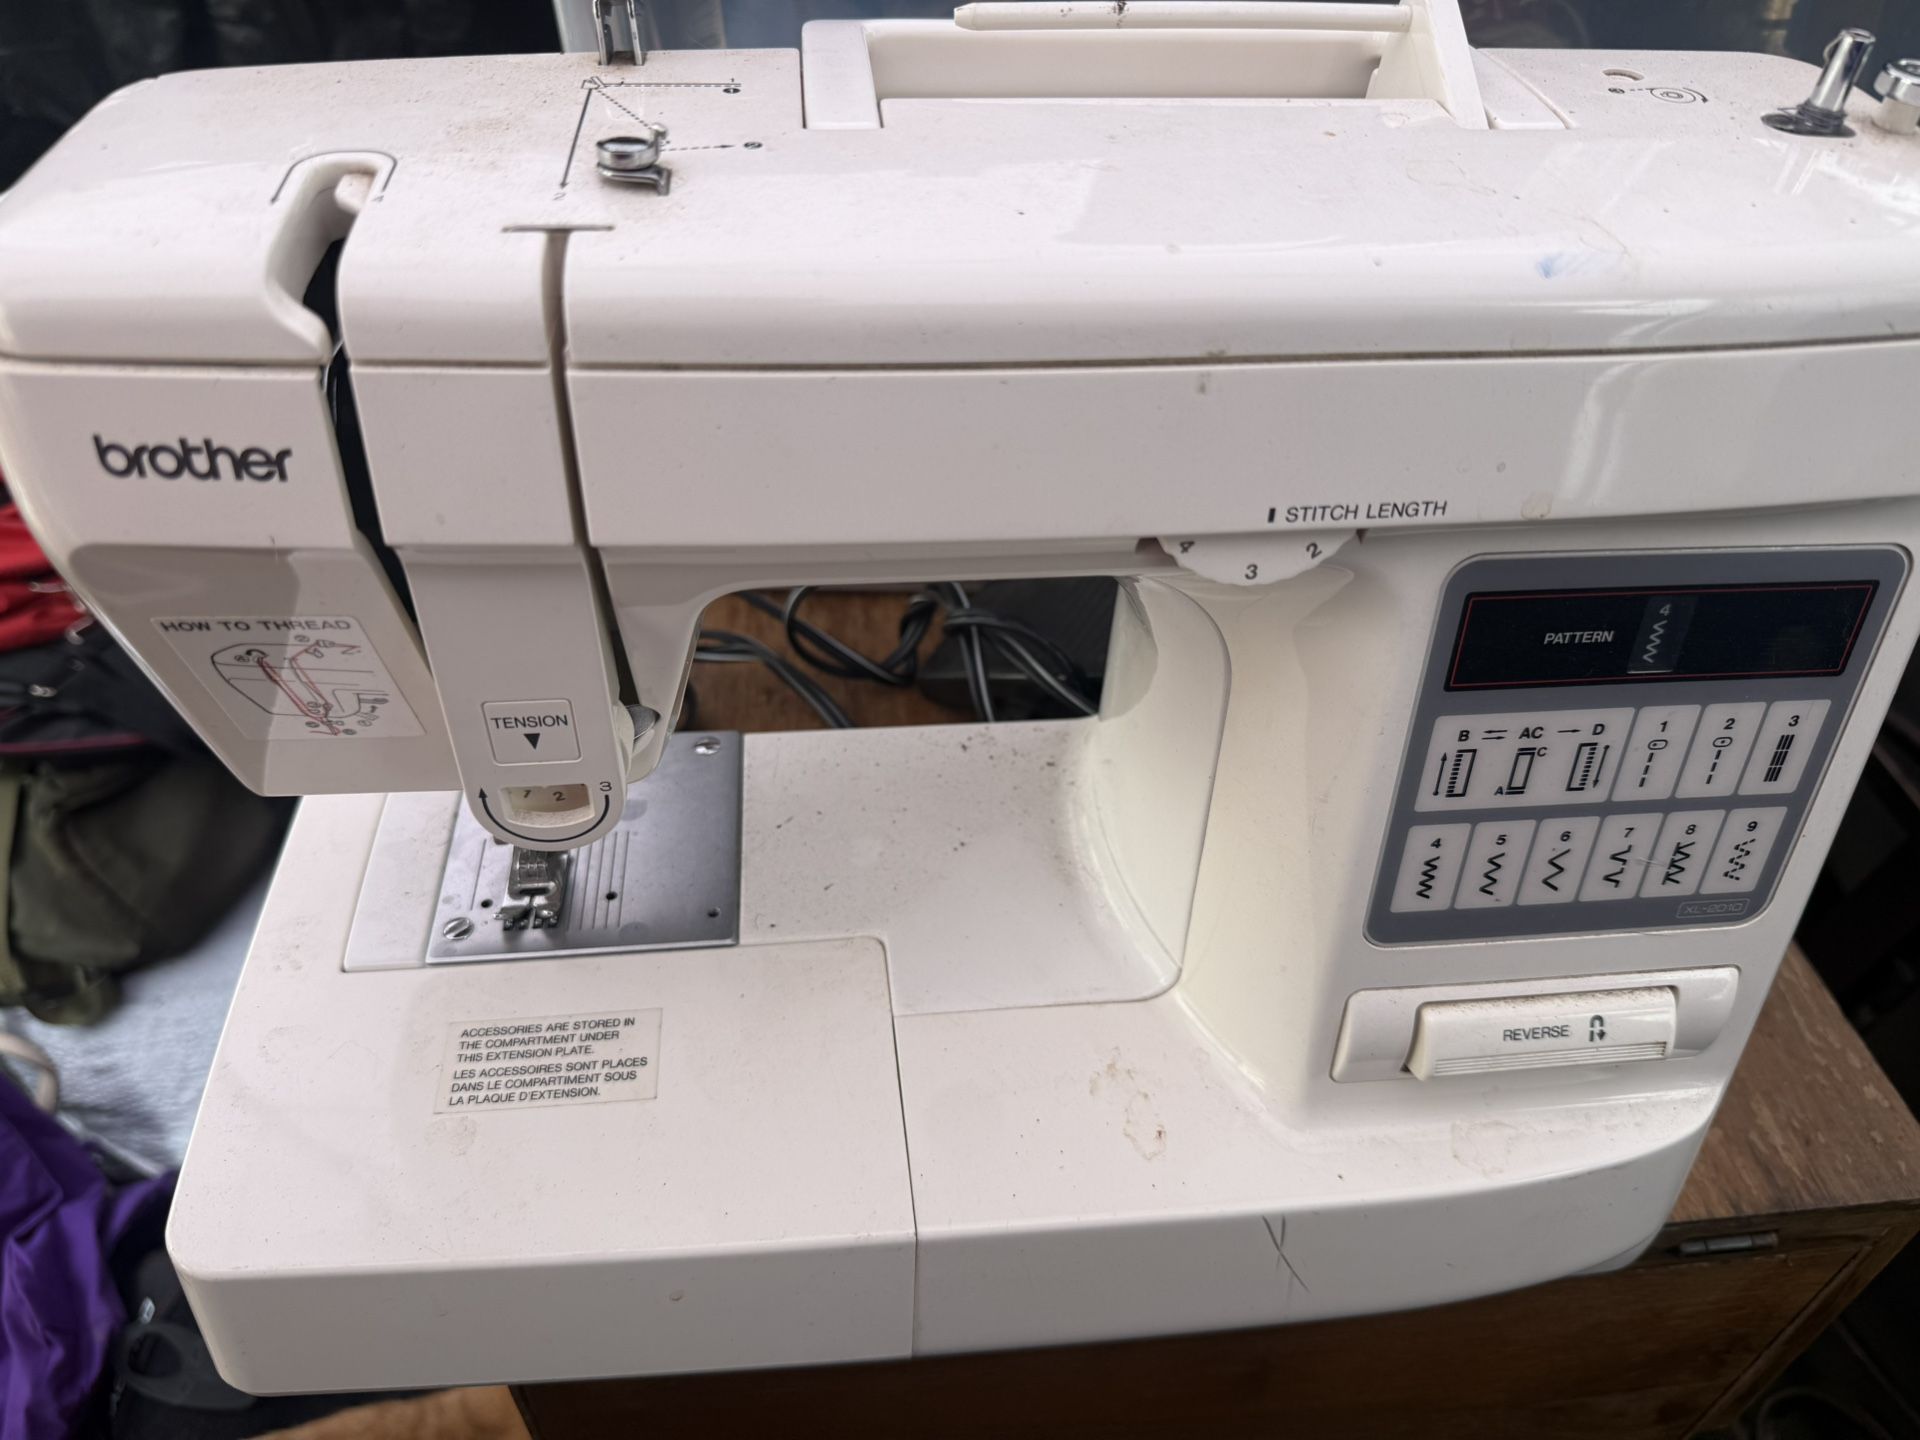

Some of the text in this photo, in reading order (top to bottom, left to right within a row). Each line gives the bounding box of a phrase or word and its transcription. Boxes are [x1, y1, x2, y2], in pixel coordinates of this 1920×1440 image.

[94, 434, 292, 482] brother
[1285, 500, 1448, 523] STITCH LENGTH
[1179, 540, 1195, 553] 4
[1305, 542, 1322, 559] 2
[1244, 564, 1258, 580] 3
[1659, 603, 1672, 615] 4
[160, 620, 351, 632] HOW TO THREAD
[1543, 630, 1614, 645] PATTERN
[490, 714, 568, 729] TENSION
[1660, 721, 1668, 732] 1
[1723, 718, 1736, 730] 2
[1788, 715, 1800, 727] 3
[1458, 724, 1605, 742] B AC D
[1537, 747, 1548, 757] C
[600, 782, 612, 792] 3
[1494, 786, 1504, 796] A
[553, 791, 566, 801] 2
[1624, 827, 1634, 838] 7
[1685, 824, 1697, 836] 8
[1747, 821, 1758, 833] 9
[1430, 838, 1442, 848] 4
[1496, 834, 1507, 846] 5
[1560, 831, 1571, 843] 6
[461, 1017, 635, 1038] ACCESSORIES ARE STORED IN
[1503, 1025, 1570, 1041] REVERSE
[460, 1030, 620, 1050] THE COMPARTMENT UNDER
[457, 1045, 595, 1063] THIS EXTENSION PLATE.
[454, 1057, 648, 1080] LES ACCESSOIRES SONT PLACES
[451, 1070, 638, 1093] DANS LE COMPARTIMENT SOUS
[449, 1085, 601, 1106] LA PLAQUE D'EXTENSION.
